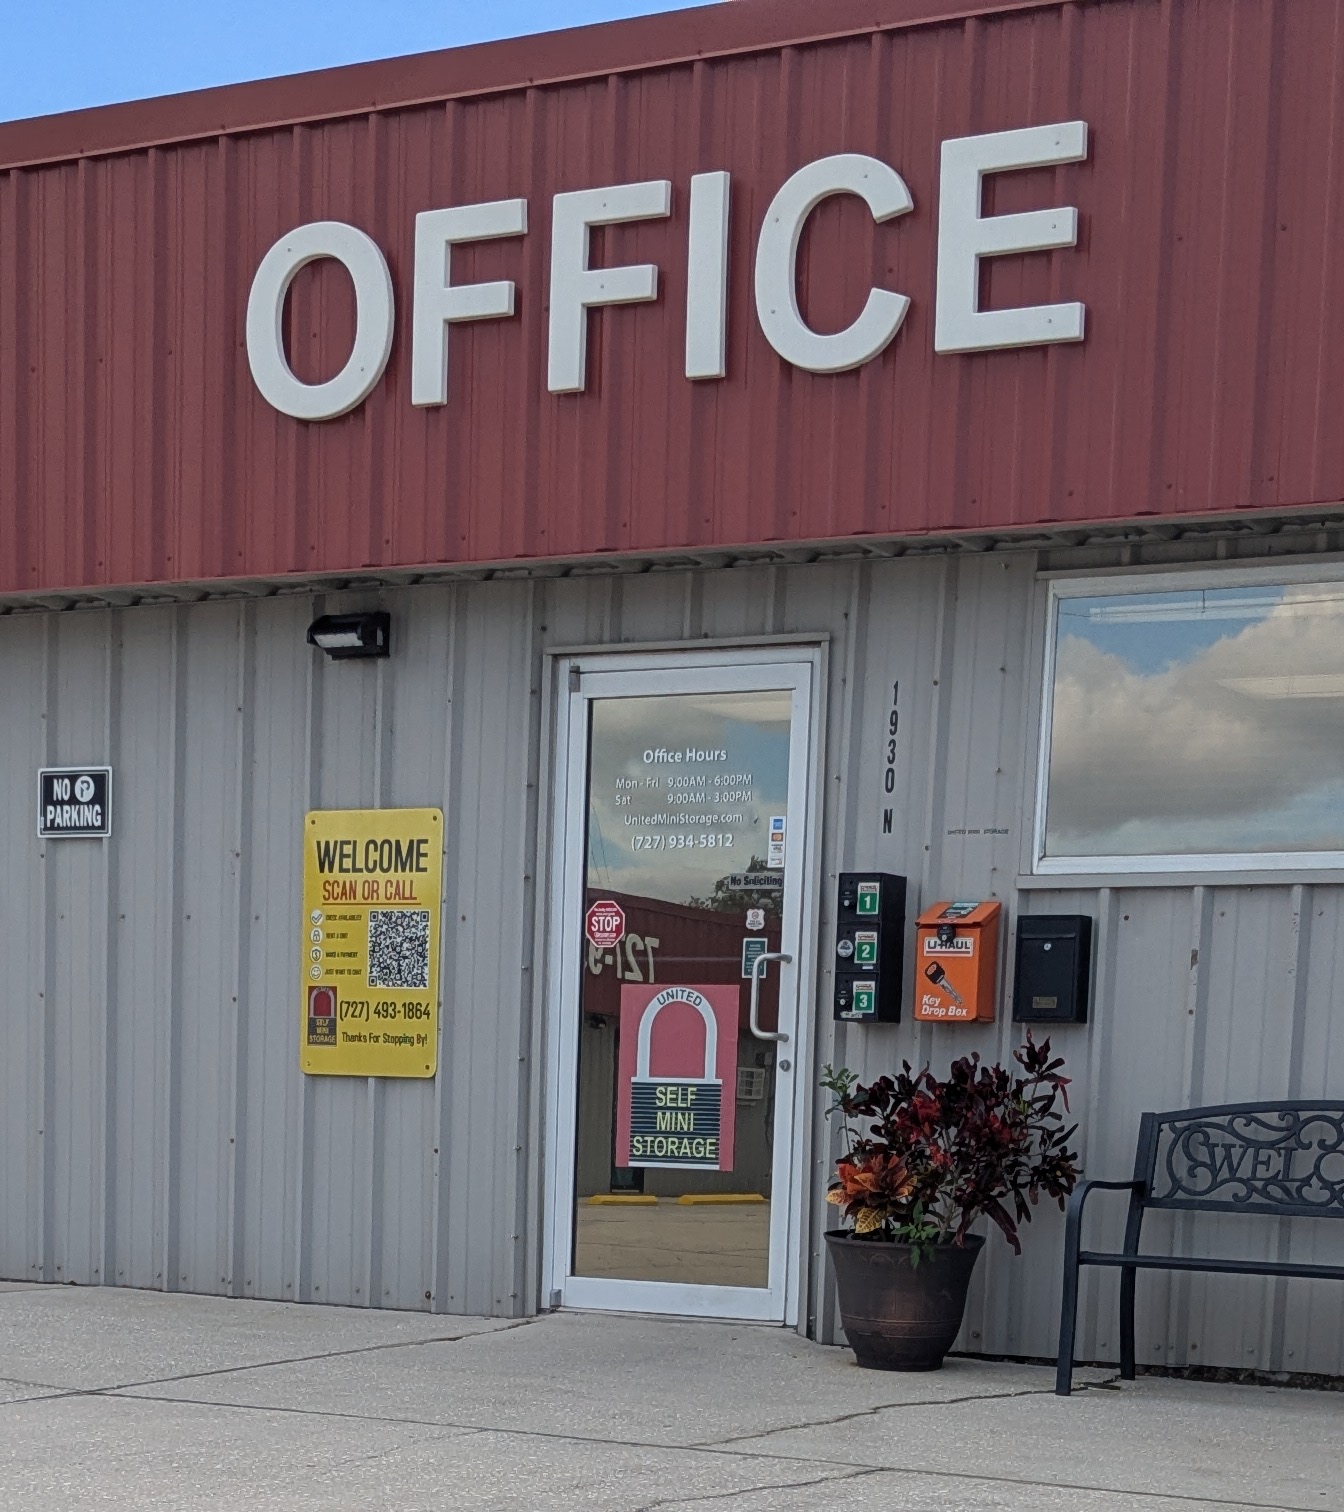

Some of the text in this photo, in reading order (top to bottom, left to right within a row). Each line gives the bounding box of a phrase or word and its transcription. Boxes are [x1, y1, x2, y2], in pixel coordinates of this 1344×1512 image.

[245, 120, 1088, 422] OFFICE
[643, 747, 728, 764] Office Hours
[883, 680, 899, 834] 1930 N
[53, 778, 71, 801] NO
[615, 778, 638, 789] Mon
[646, 777, 660, 789] Fri
[667, 776, 706, 788] 9:00AM
[714, 774, 753, 787] 6:00PM
[615, 794, 632, 806] Sat
[667, 792, 706, 804] 9:00AM
[713, 790, 753, 803] 3:00PM
[46, 804, 102, 827] PARKING
[624, 812, 744, 827] UnitedMiniStorage.com
[631, 833, 735, 851] (727) 934-5812
[316, 838, 429, 874] WELCOME
[730, 875, 783, 887] No Soliciting
[322, 880, 418, 901] SCAN OR CALL
[864, 895, 871, 909] 1
[591, 916, 621, 932] STOP
[861, 944, 870, 958] 2
[656, 988, 703, 1007] UNITED
[859, 994, 868, 1008] 3
[922, 994, 941, 1007] Key
[339, 1000, 431, 1022] (727) 493-1864
[921, 1005, 968, 1017] Drop Box
[341, 1031, 428, 1047] Thanks For Stopping By!
[656, 1086, 698, 1107] SELF
[656, 1111, 694, 1132] MINI
[632, 1136, 716, 1158] STORAGE
